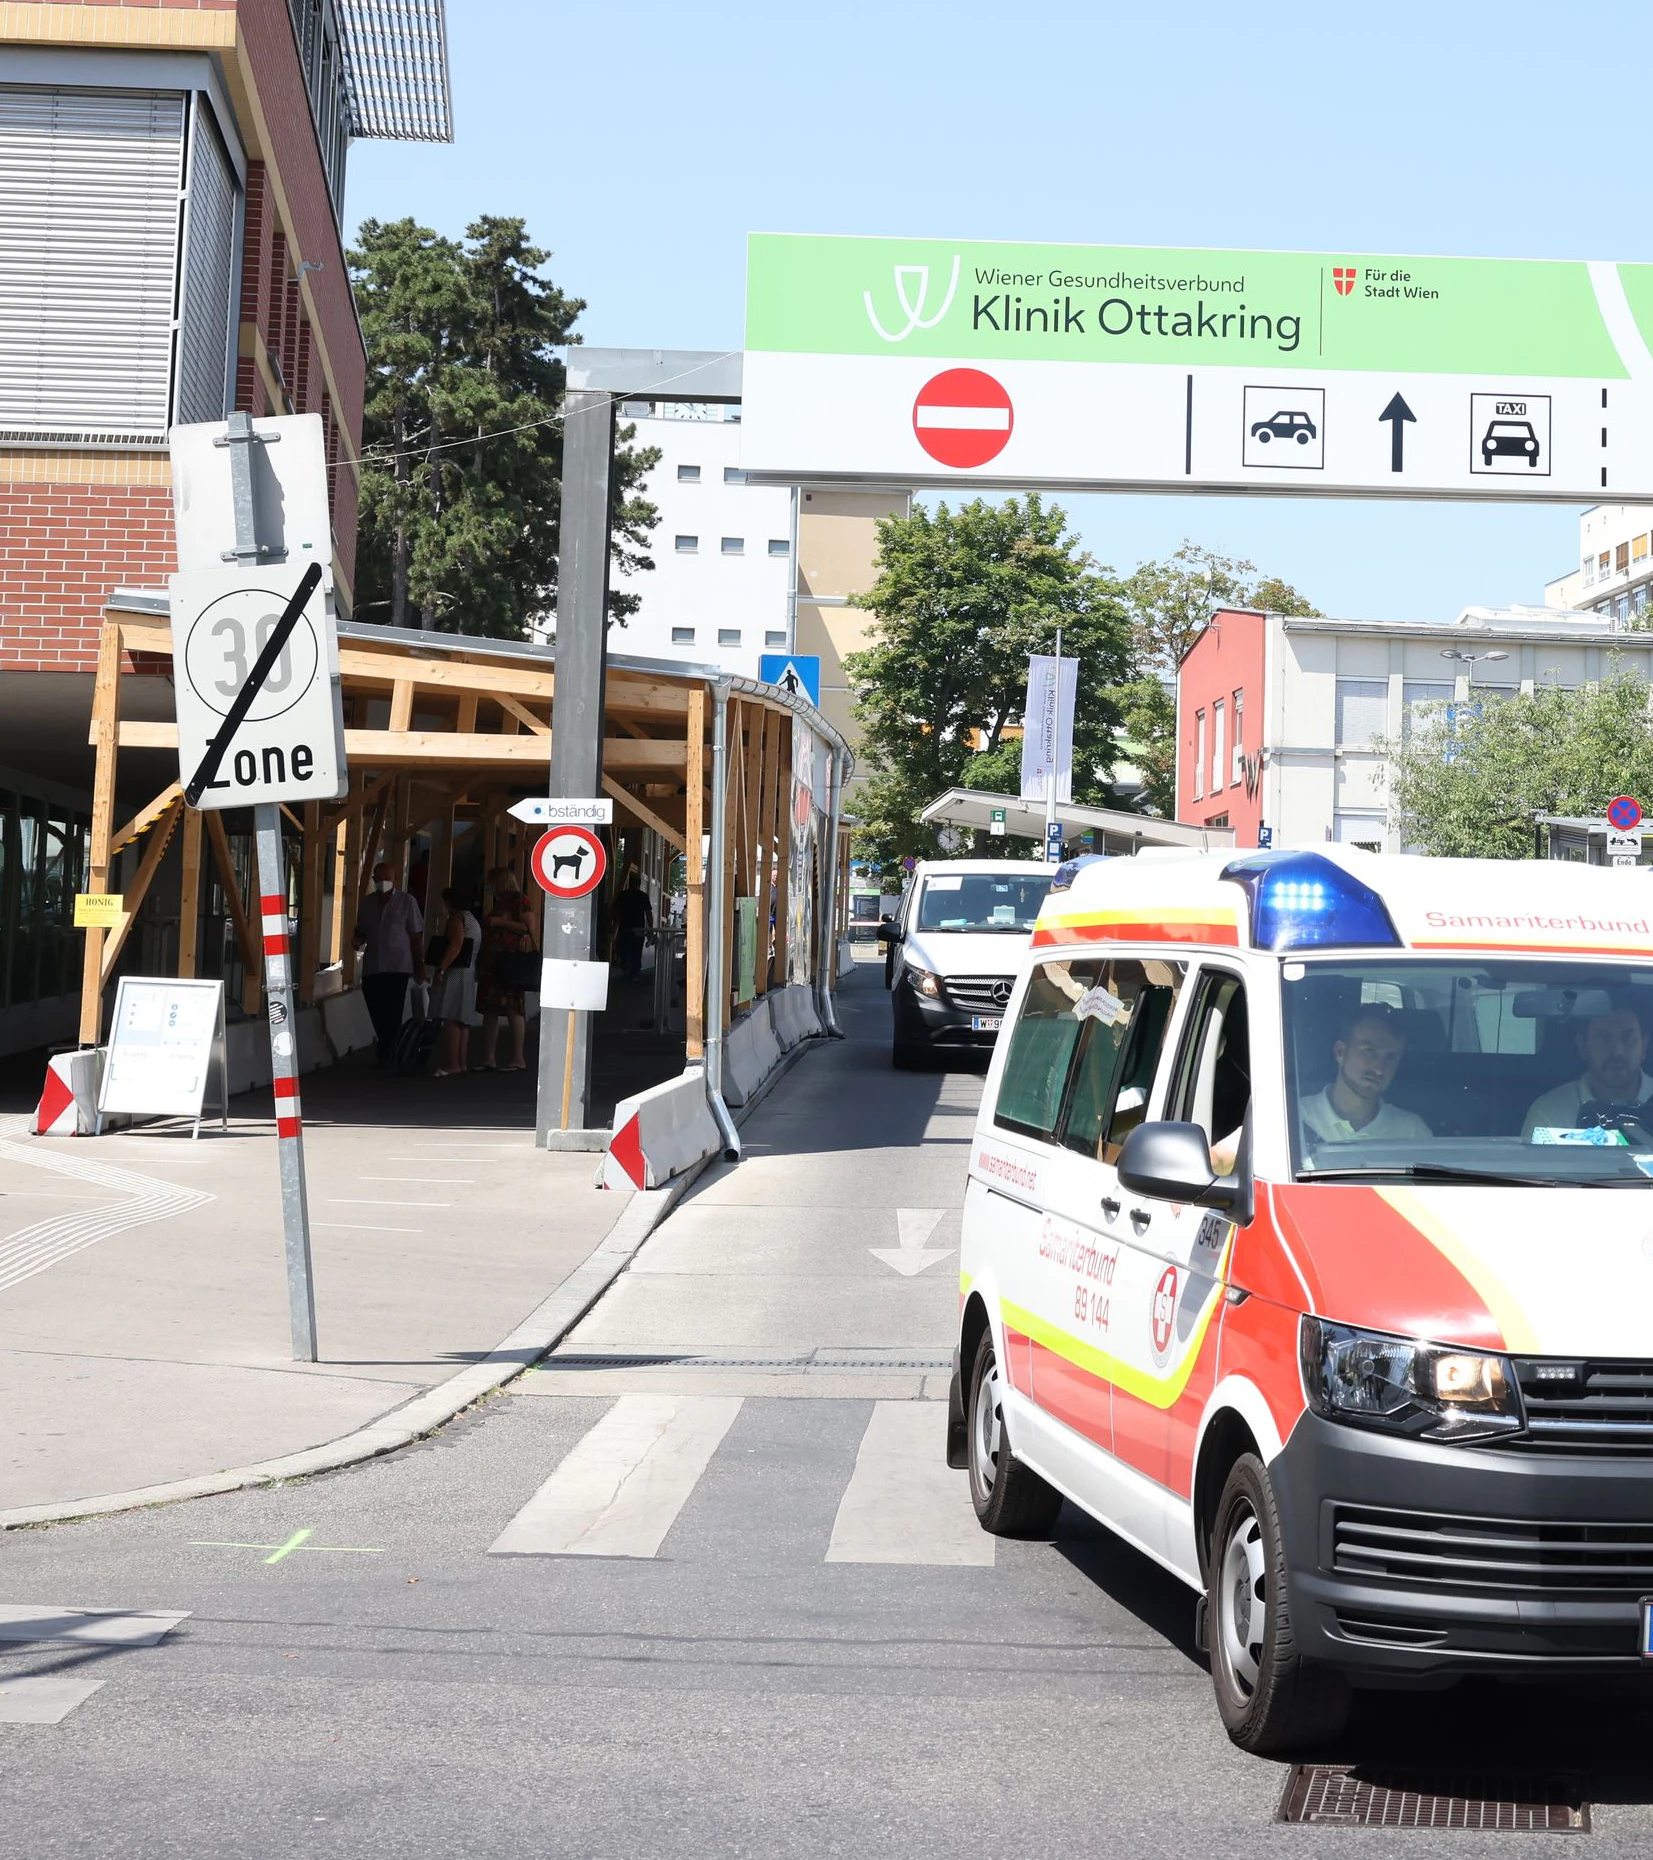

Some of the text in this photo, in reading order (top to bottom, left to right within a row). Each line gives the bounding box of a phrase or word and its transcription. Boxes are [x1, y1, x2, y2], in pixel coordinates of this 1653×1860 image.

[974, 268, 1245, 293] Wiener Gesundheitsverbund
[1364, 285, 1439, 299] Stadt Wien
[1365, 269, 1411, 282] Für die
[972, 294, 1301, 352] Klinik Ottakring
[1496, 403, 1525, 415] TAXI
[211, 613, 293, 697] 30
[206, 739, 314, 789] Zone
[86, 898, 113, 906] HONIG
[1425, 911, 1650, 934] Samariterbund
[978, 1151, 1037, 1191] www.samariterbund.net
[1198, 1216, 1222, 1249] 345
[1039, 1218, 1120, 1286] Samariterbund
[1075, 1285, 1110, 1333] 89 144
